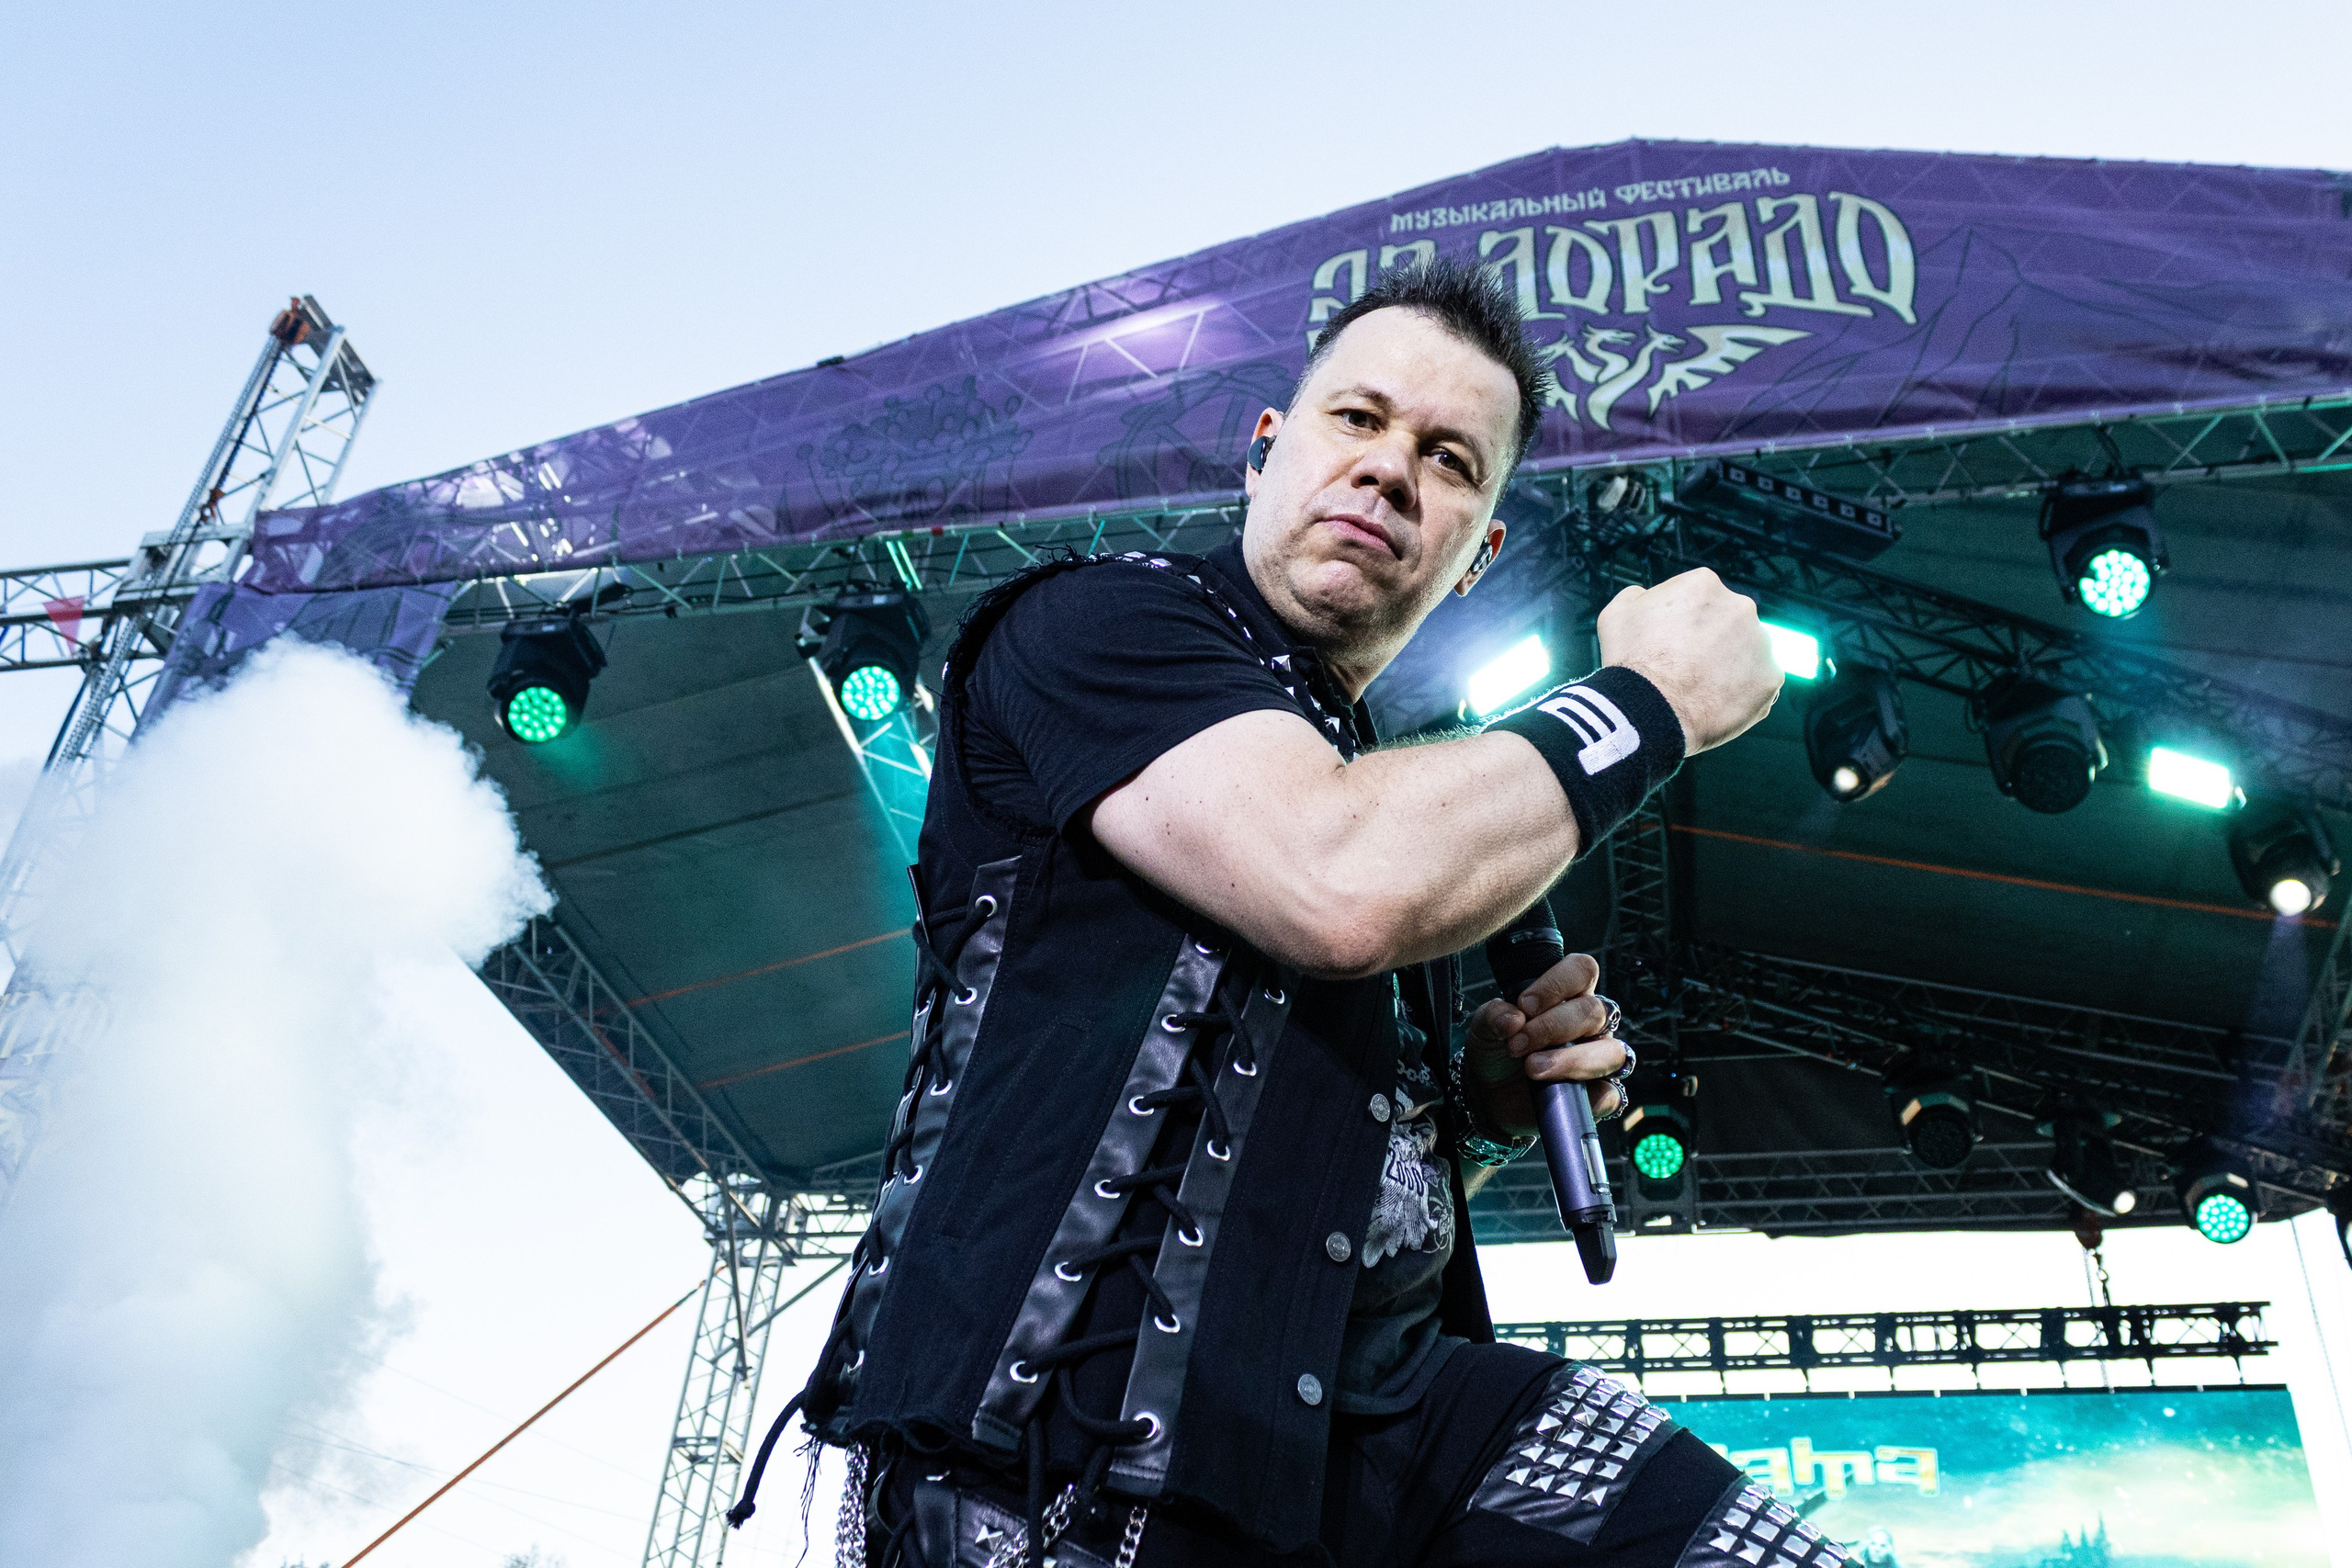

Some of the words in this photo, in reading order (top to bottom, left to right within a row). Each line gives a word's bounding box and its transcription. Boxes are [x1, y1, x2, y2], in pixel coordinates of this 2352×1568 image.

[1390, 186, 1607, 232] МУЗЫКАЛЬНЫЙ
[1614, 166, 1791, 204] ФЕСТИВАЛЬ
[1306, 191, 1917, 356] ЭДОРАДО
